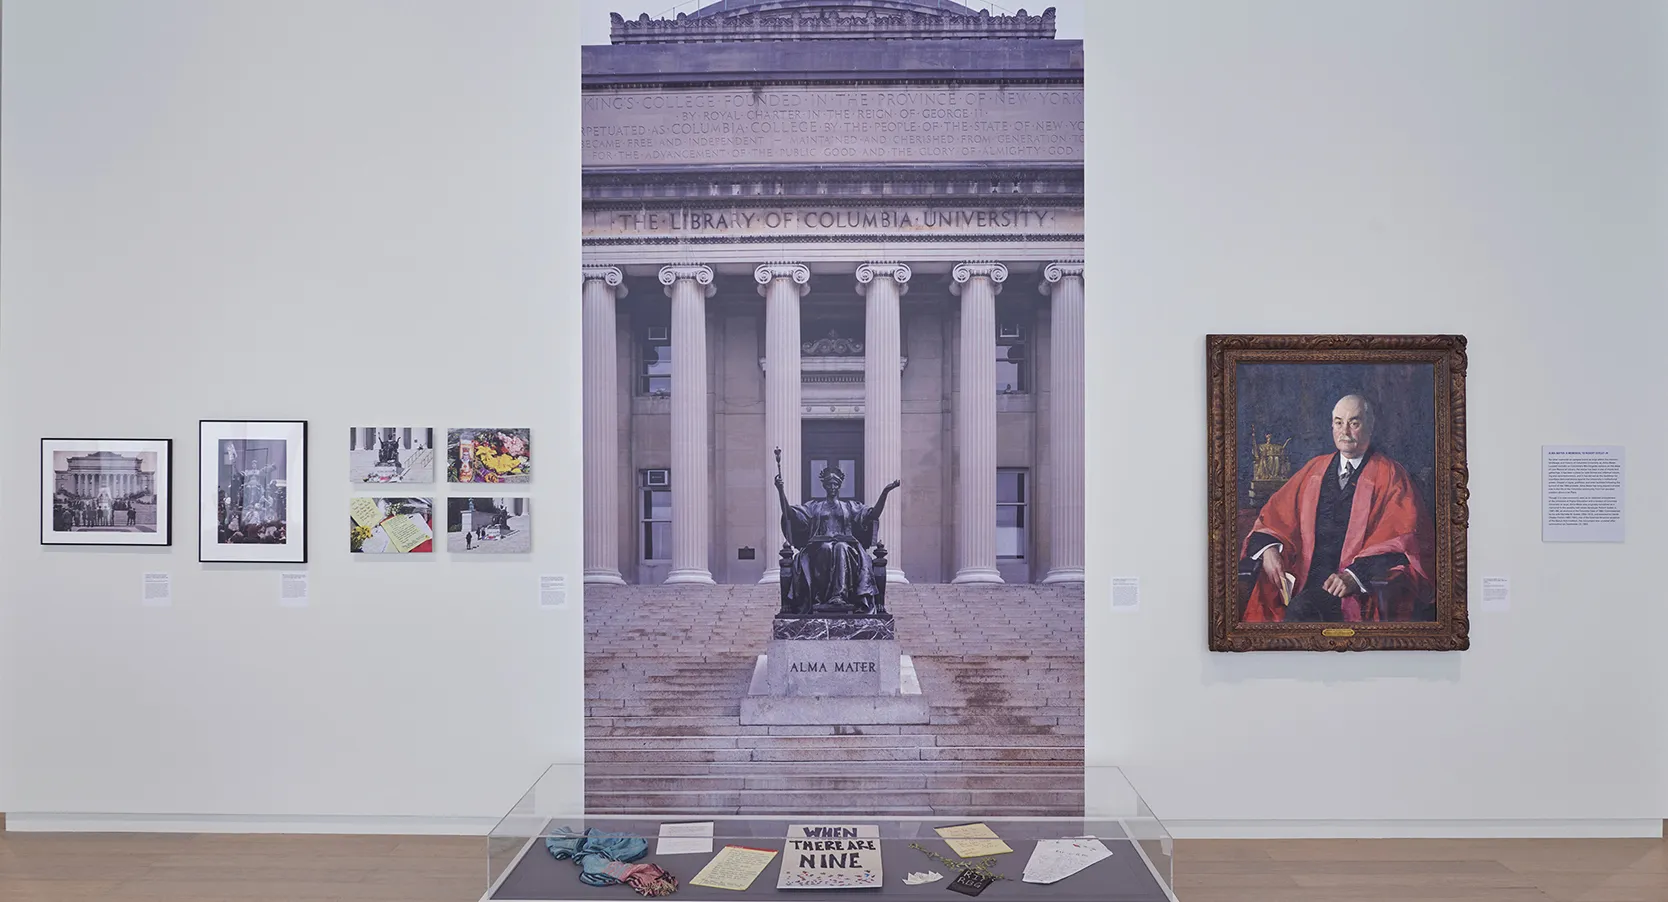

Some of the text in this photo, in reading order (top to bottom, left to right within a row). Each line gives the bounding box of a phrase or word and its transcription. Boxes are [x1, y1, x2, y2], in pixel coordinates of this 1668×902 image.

[642, 95, 716, 109] COLLEGE
[724, 94, 801, 107] FOUNDED
[811, 94, 827, 106] IN
[835, 93, 868, 106] THE
[878, 92, 956, 106] PROVINCE
[965, 93, 986, 106] OF
[995, 92, 1031, 105] NEW
[1039, 92, 1082, 105] YORK
[682, 111, 697, 121] BY
[704, 111, 741, 121] ROYAL
[746, 110, 801, 120] CHARTER
[808, 109, 820, 119] IN
[826, 109, 850, 119] THE
[858, 109, 892, 119] REIGN
[899, 109, 916, 119] OF
[922, 108, 969, 119] GEORGE
[651, 125, 666, 135] AS
[671, 122, 745, 134] COLUMBIA
[751, 121, 817, 133] COLLEGE
[824, 122, 838, 132] BY
[844, 122, 868, 132] THE
[874, 122, 917, 132] PEOPLE
[922, 121, 939, 132] OF
[943, 121, 968, 131] THE
[974, 121, 1008, 131] STATE
[1014, 121, 1031, 131] OF
[1036, 120, 1063, 131] NEW
[627, 138, 652, 148] FREE
[660, 138, 681, 146] AND
[688, 136, 764, 146] INDEPENDENT
[789, 135, 858, 145] MAINTAINED
[864, 135, 887, 144] AND
[893, 135, 954, 144] CHERISHED
[961, 135, 990, 143] FROM
[997, 134, 1067, 143] GENERATION
[592, 146, 1074, 160] FOR THE ADVANCEMENT OF THE PUBLIC GOOD AND THE GLORY OF ALMIGHTY GOD
[618, 210, 1048, 230] THE LIBRARY OF COLUMBIA UNIVERSITY
[790, 661, 877, 673] ALMA MATER
[803, 827, 858, 838] WHEN
[789, 840, 876, 851] THERE ARE
[799, 852, 863, 869] NINE
[957, 876, 983, 889] RBG
